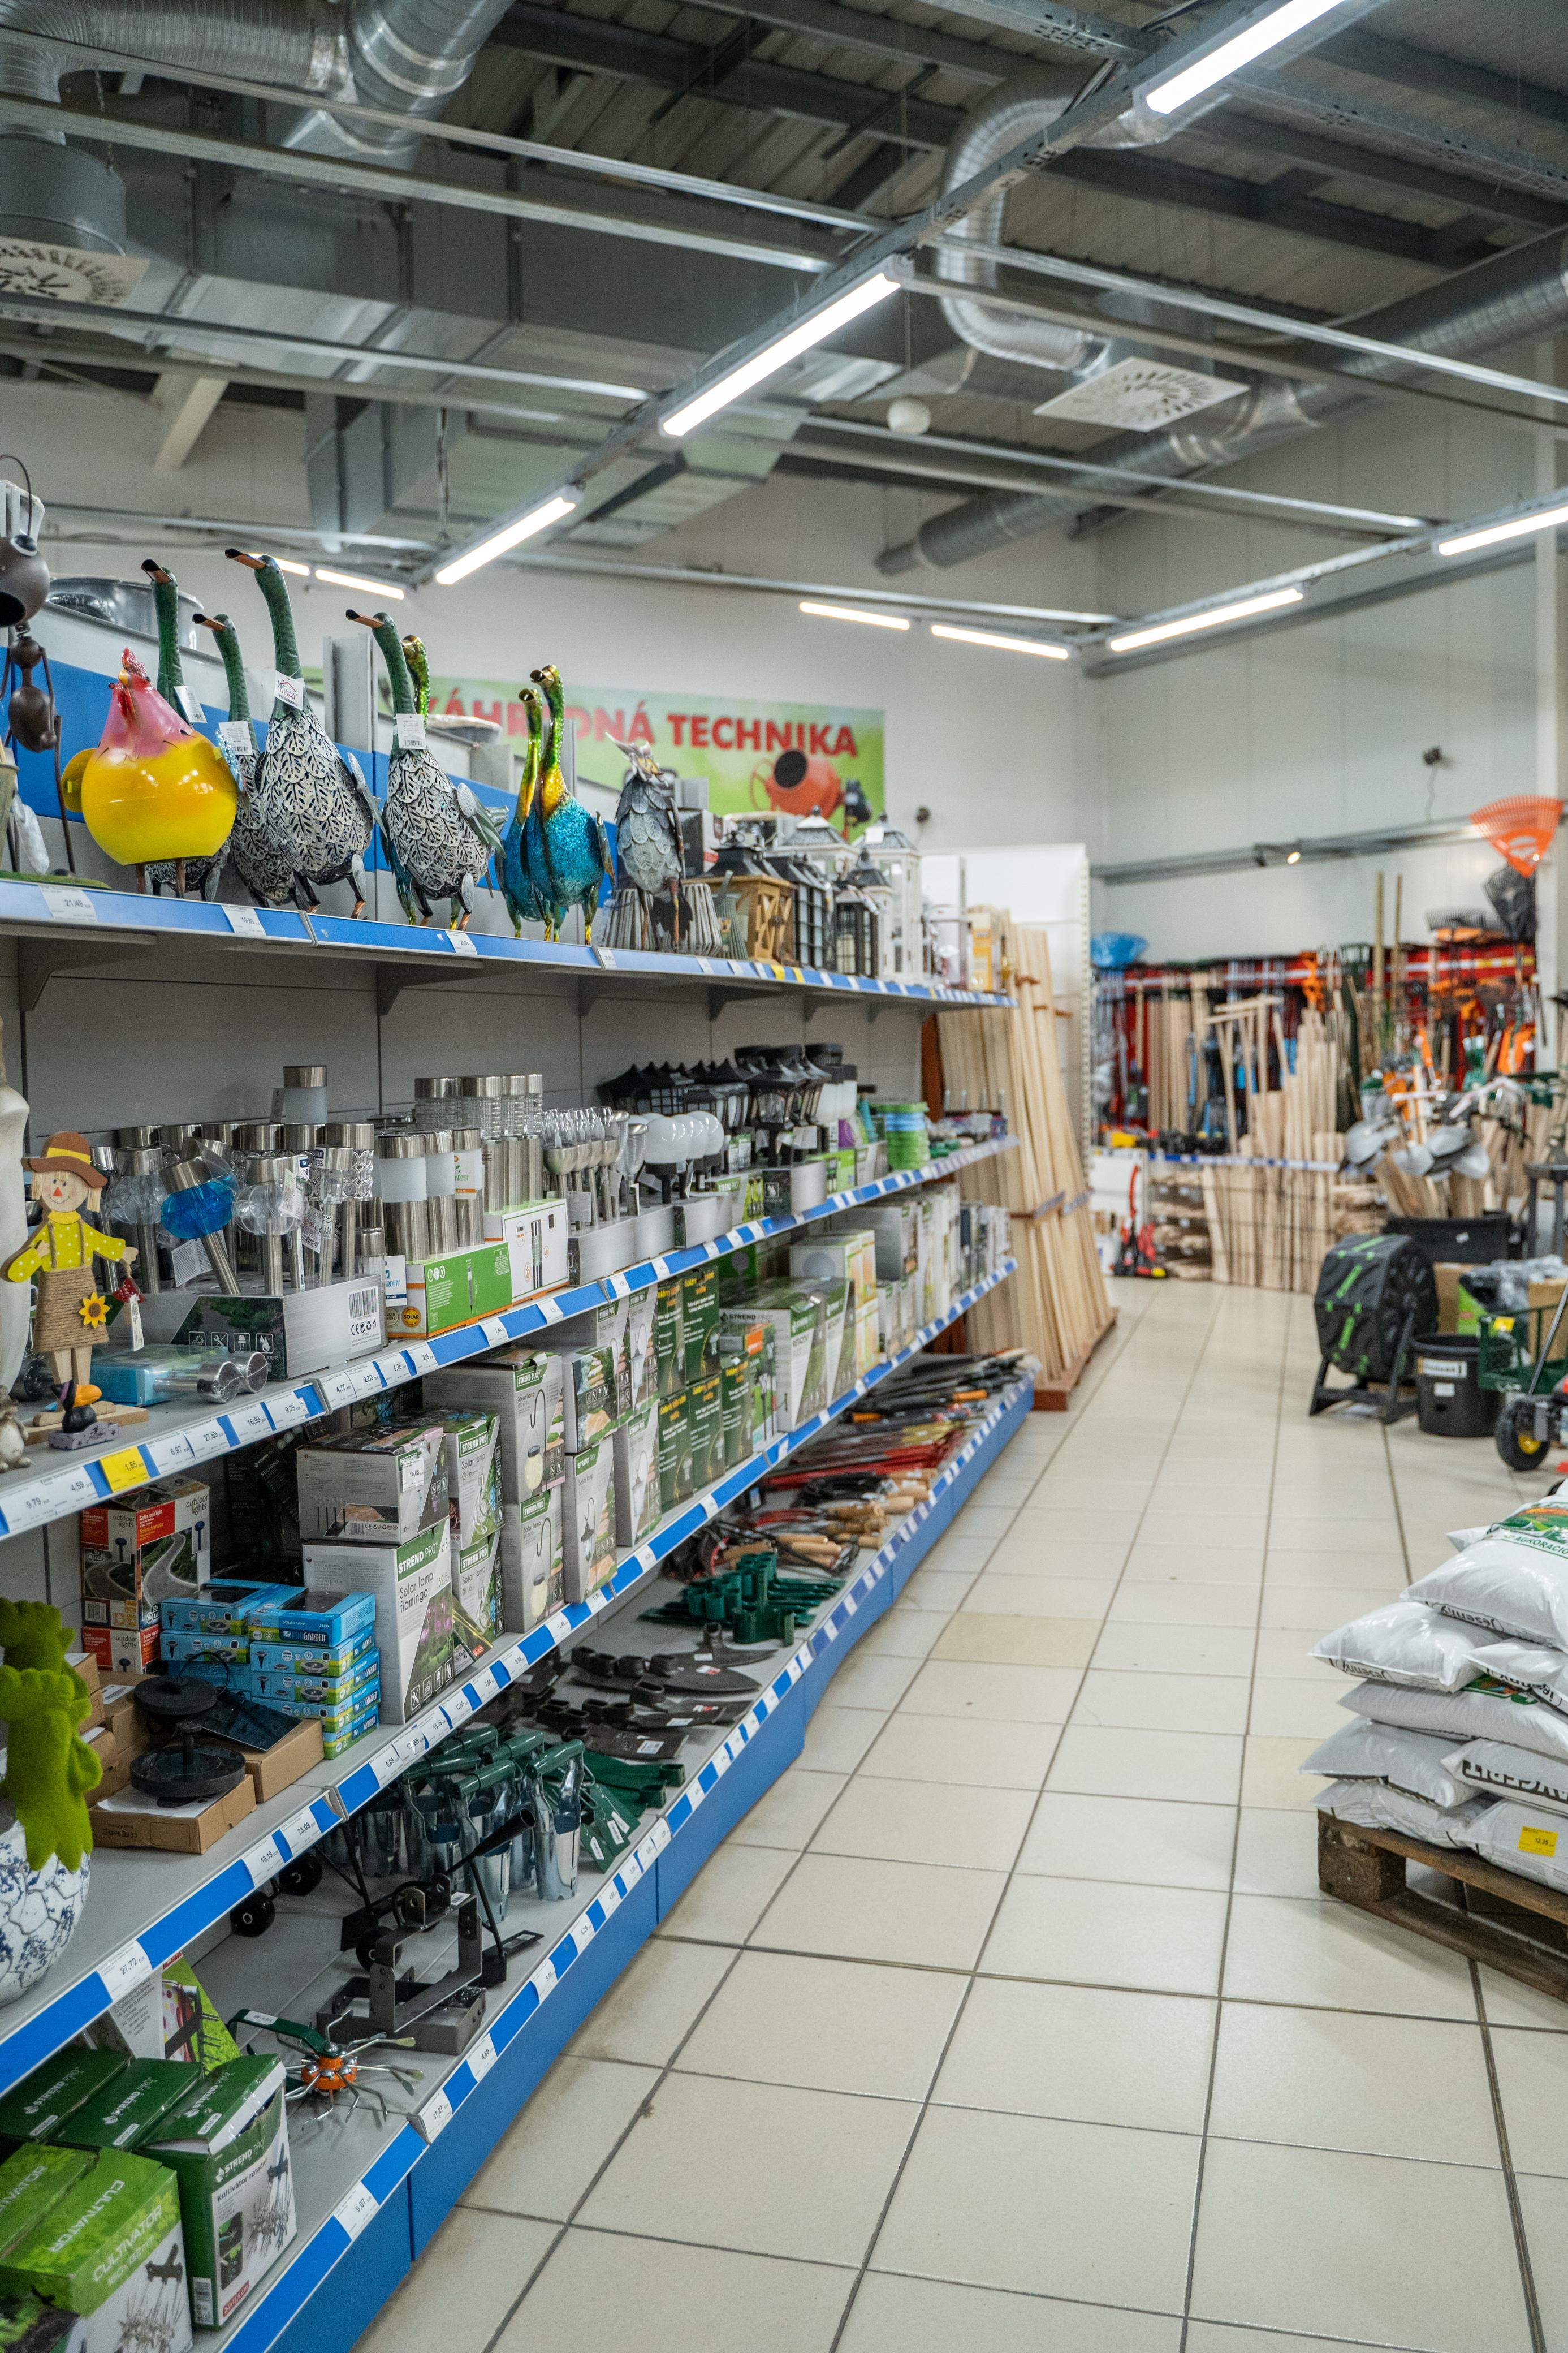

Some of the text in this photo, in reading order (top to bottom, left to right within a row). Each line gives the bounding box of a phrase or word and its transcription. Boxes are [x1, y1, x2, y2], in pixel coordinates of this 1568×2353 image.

[667, 714, 858, 758] TECHNIKA
[336, 1384, 345, 1393] 4,77
[285, 1404, 295, 1413] 9,29
[247, 1416, 261, 1427] 16,99
[171, 1445, 182, 1456] 6,97
[462, 1434, 487, 1454] STREND PRO
[461, 1454, 485, 1470] Solar lamp
[71, 1481, 85, 1492] 4,59
[26, 1497, 42, 1510] 9,79
[186, 1494, 208, 1509] outdoor
[191, 1502, 207, 1516] lights
[113, 1514, 135, 1523] outdoor
[120, 1519, 134, 1528] lights
[398, 1544, 436, 1575] STREND PRO
[462, 1547, 487, 1569] STREND PRO
[462, 1566, 485, 1585] Solar lamp
[399, 1570, 434, 1600] Solar lamp
[400, 1588, 429, 1613] flamingo
[115, 1636, 138, 1644] outdoor
[121, 1640, 137, 1649] lights
[386, 1757, 395, 1768] 6,09
[297, 1822, 310, 1835] 23,09
[260, 1850, 273, 1864] 10,19
[119, 1957, 139, 1976] 27,72
[33, 2067, 80, 2106] STREND PRO
[139, 2077, 154, 2092] PRO
[224, 2137, 265, 2174] STREND PRO
[217, 2159, 268, 2203] Kultivátor rotačný
[355, 2197, 366, 2212] 9,07
[49, 2180, 126, 2253] CULTIVATOR
[93, 2205, 163, 2283] CULTIVATOR
